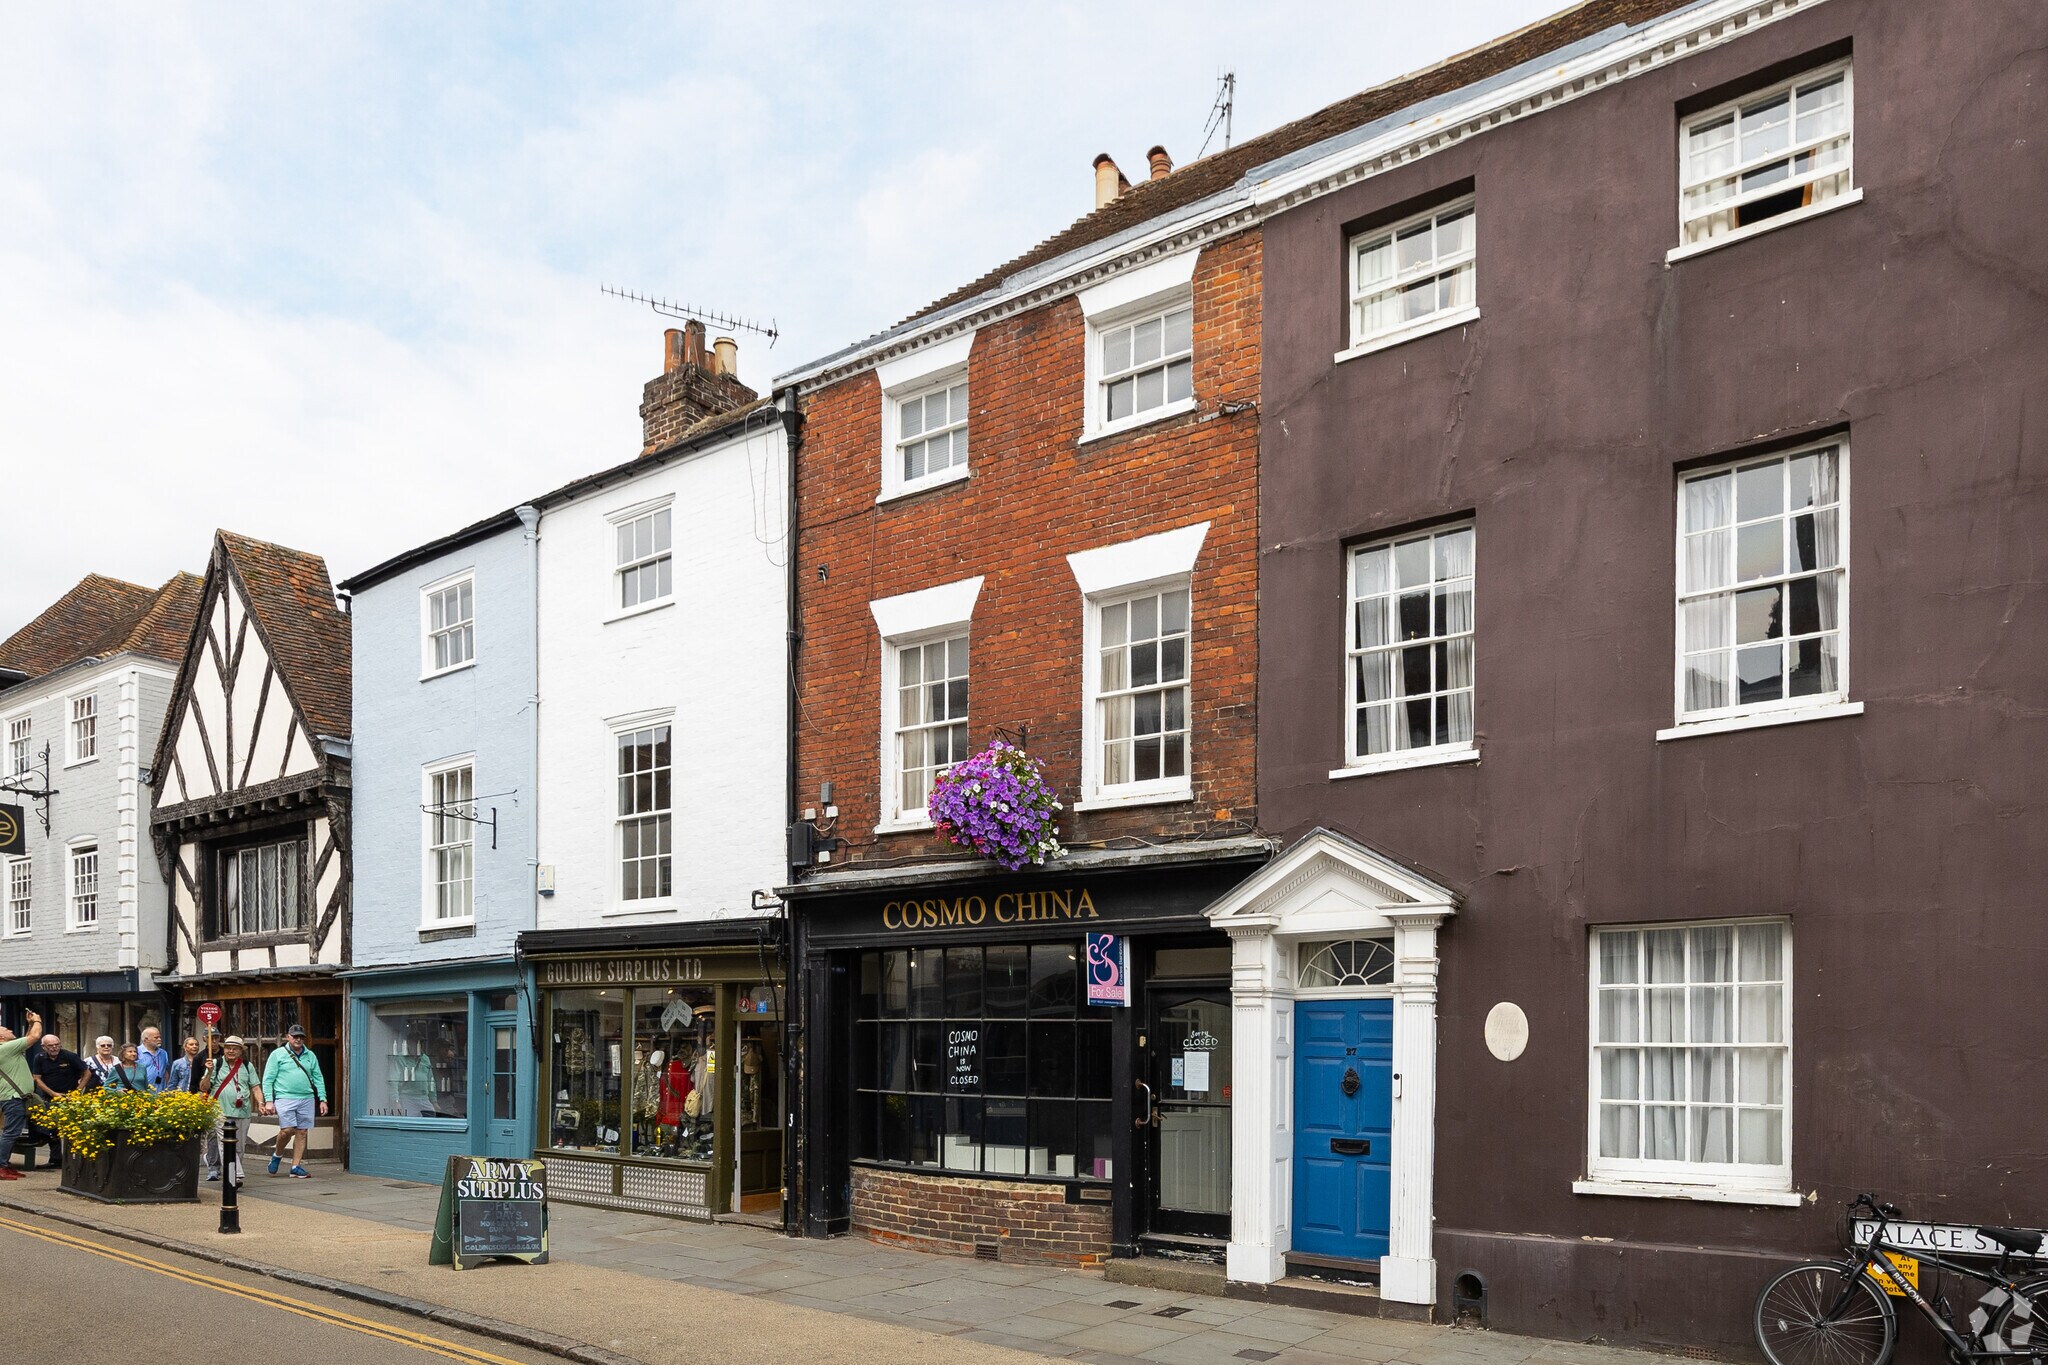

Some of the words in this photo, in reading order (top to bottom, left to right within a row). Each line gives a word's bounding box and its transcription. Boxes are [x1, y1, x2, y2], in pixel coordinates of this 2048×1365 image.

[882, 895, 987, 930] COSMO
[994, 888, 1100, 923] CHINA
[547, 962, 602, 983] GOLDING
[607, 959, 670, 982] SURPLUS
[676, 958, 702, 980] LTD
[28, 982, 62, 991] TWENTYTWO
[62, 980, 84, 991] BRIDAL
[1091, 986, 1104, 997] For
[1105, 986, 1123, 998] Sale
[948, 1030, 978, 1044] COSMO
[1182, 1037, 1219, 1047] CLOSED
[948, 1044, 977, 1058] CHINA
[1345, 1047, 1358, 1056] 27
[955, 1064, 972, 1072] NOW
[950, 1075, 979, 1085] CLOSED
[369, 1107, 408, 1117] DAYANI
[466, 1161, 532, 1180] ARMY
[457, 1180, 545, 1200] SURPLUS
